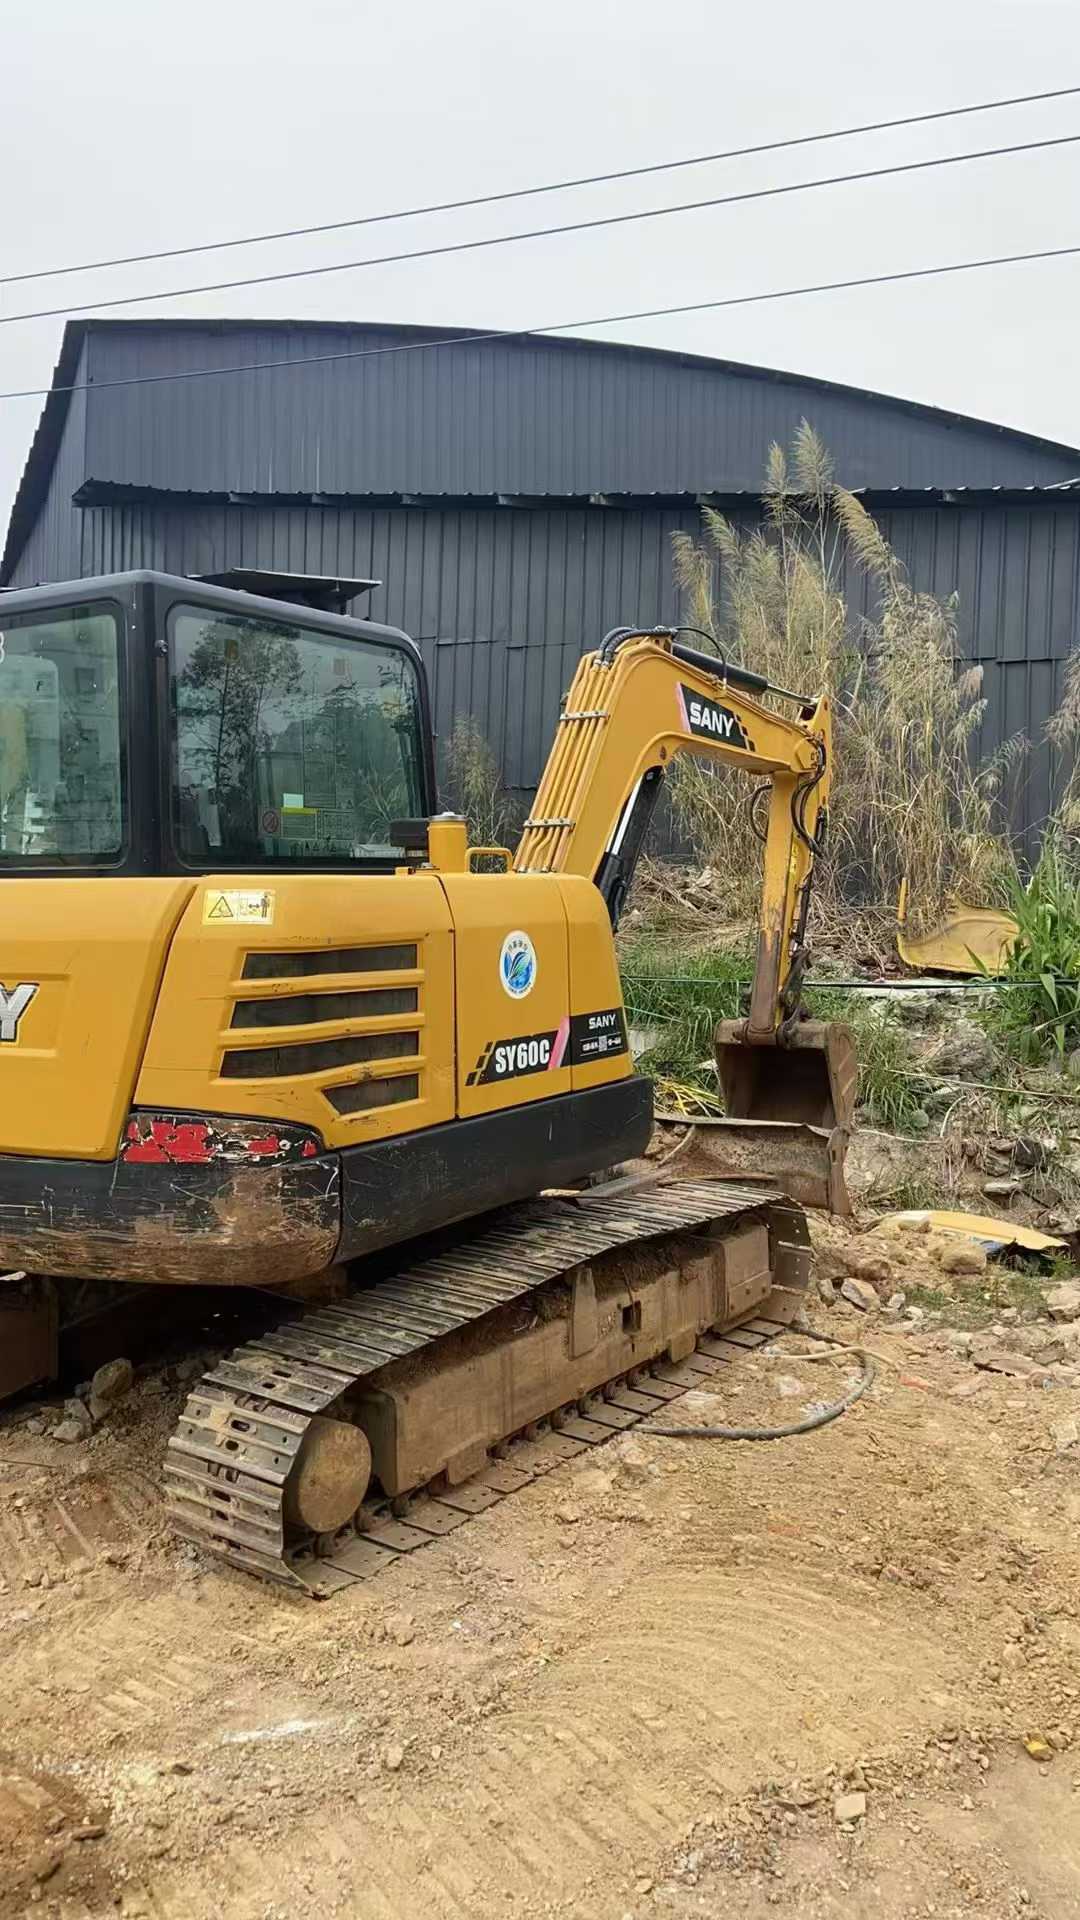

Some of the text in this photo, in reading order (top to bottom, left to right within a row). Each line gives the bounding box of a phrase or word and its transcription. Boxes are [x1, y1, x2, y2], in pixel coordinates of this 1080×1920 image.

[690, 702, 734, 737] SANY
[589, 1013, 616, 1030] SANY
[495, 1039, 550, 1073] SY60C
